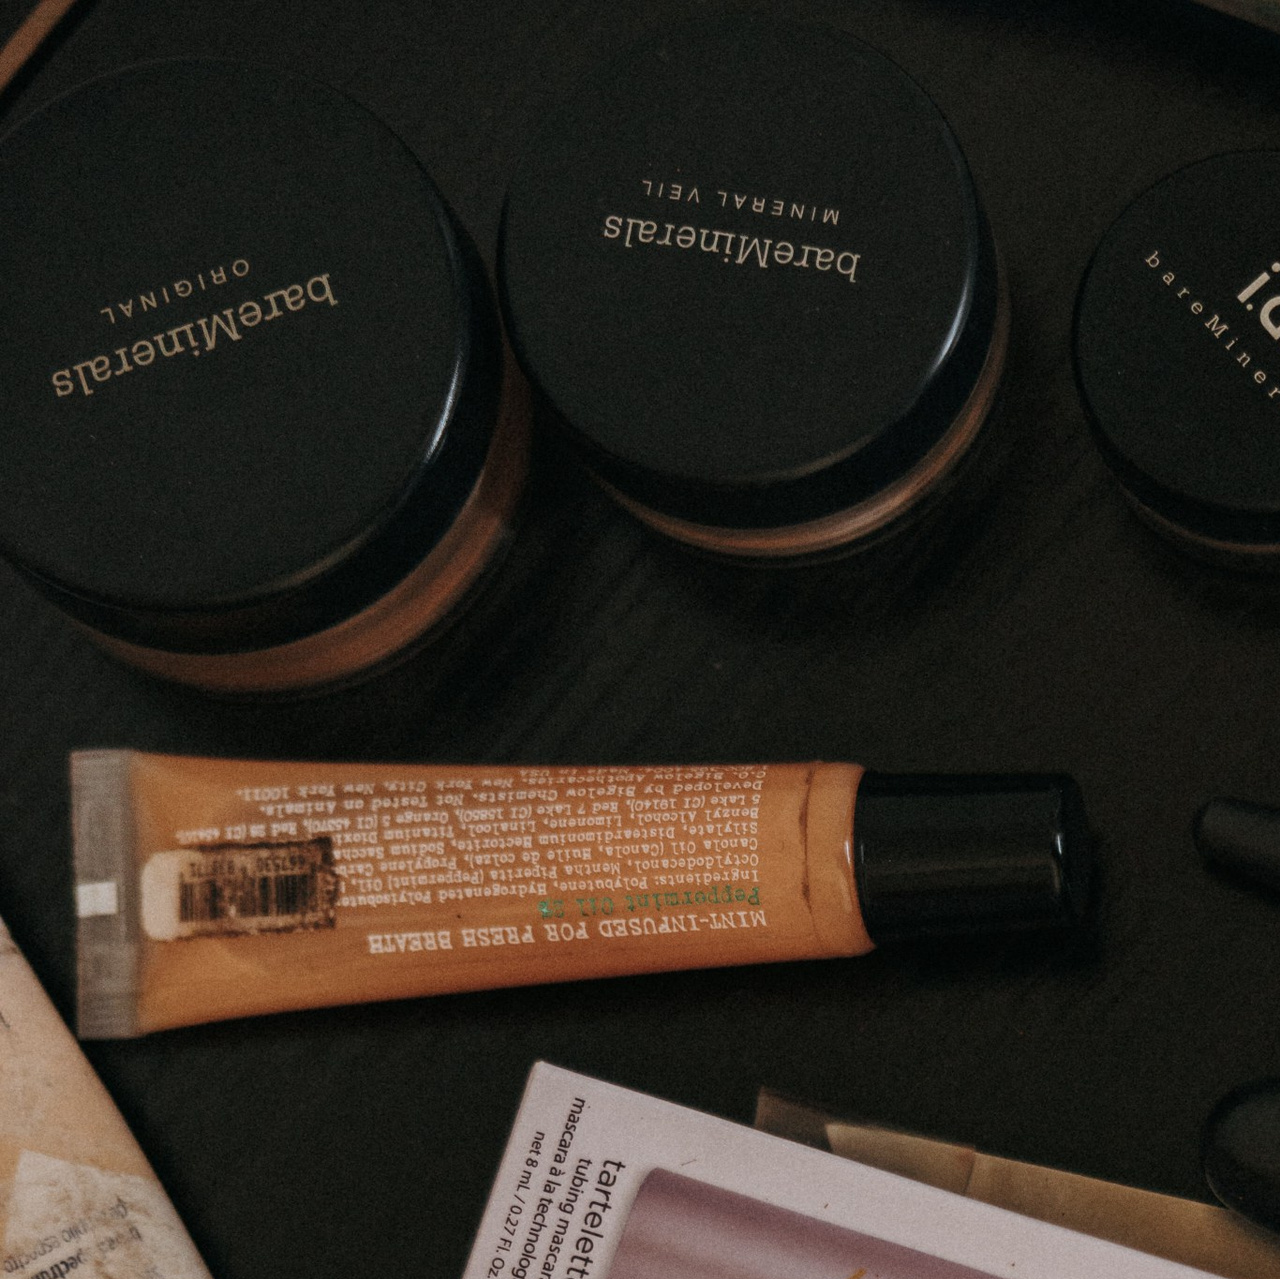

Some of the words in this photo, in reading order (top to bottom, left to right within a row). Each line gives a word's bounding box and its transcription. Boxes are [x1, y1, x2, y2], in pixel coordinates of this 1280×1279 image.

[642, 179, 700, 203] VEIL
[717, 190, 840, 226] MINERAL
[603, 215, 861, 283] bareMinerals
[100, 258, 250, 324] ORIGINAL
[51, 273, 338, 397] bareMinerals
[644, 783, 665, 796] by
[437, 794, 464, 806] Not
[592, 801, 618, 814] Red
[710, 794, 746, 807] Lake
[395, 810, 449, 824] Orange
[536, 803, 571, 817] Lake
[705, 806, 759, 822] Benzyl
[383, 825, 454, 841] Titanium
[390, 841, 445, 857] Sodium
[670, 840, 697, 855] Oil
[703, 837, 758, 852] Canola
[522, 851, 540, 865] de
[547, 847, 592, 862] Huile
[380, 855, 457, 873] Propylene
[489, 863, 558, 881] Piperita
[563, 862, 621, 876] Mentha
[553, 874, 648, 892] Polybutene,
[653, 867, 759, 886] Ingredients:
[438, 880, 548, 903] Hydrogenated
[623, 882, 760, 915] Peppermint
[574, 895, 614, 917] Oil
[543, 921, 589, 942] FOR
[598, 909, 767, 938] MINT-INFUSED
[367, 930, 452, 954] BREATH
[460, 924, 535, 947] FRESH
[553, 1097, 586, 1164] mascara
[529, 1131, 545, 1156] net
[525, 1157, 539, 1168] 8
[548, 1166, 565, 1177] à
[516, 1169, 532, 1191] mL
[543, 1179, 561, 1194] la
[557, 1158, 593, 1215] tubing
[503, 1204, 523, 1237] 0.27
[487, 1256, 506, 1279] Oz.
